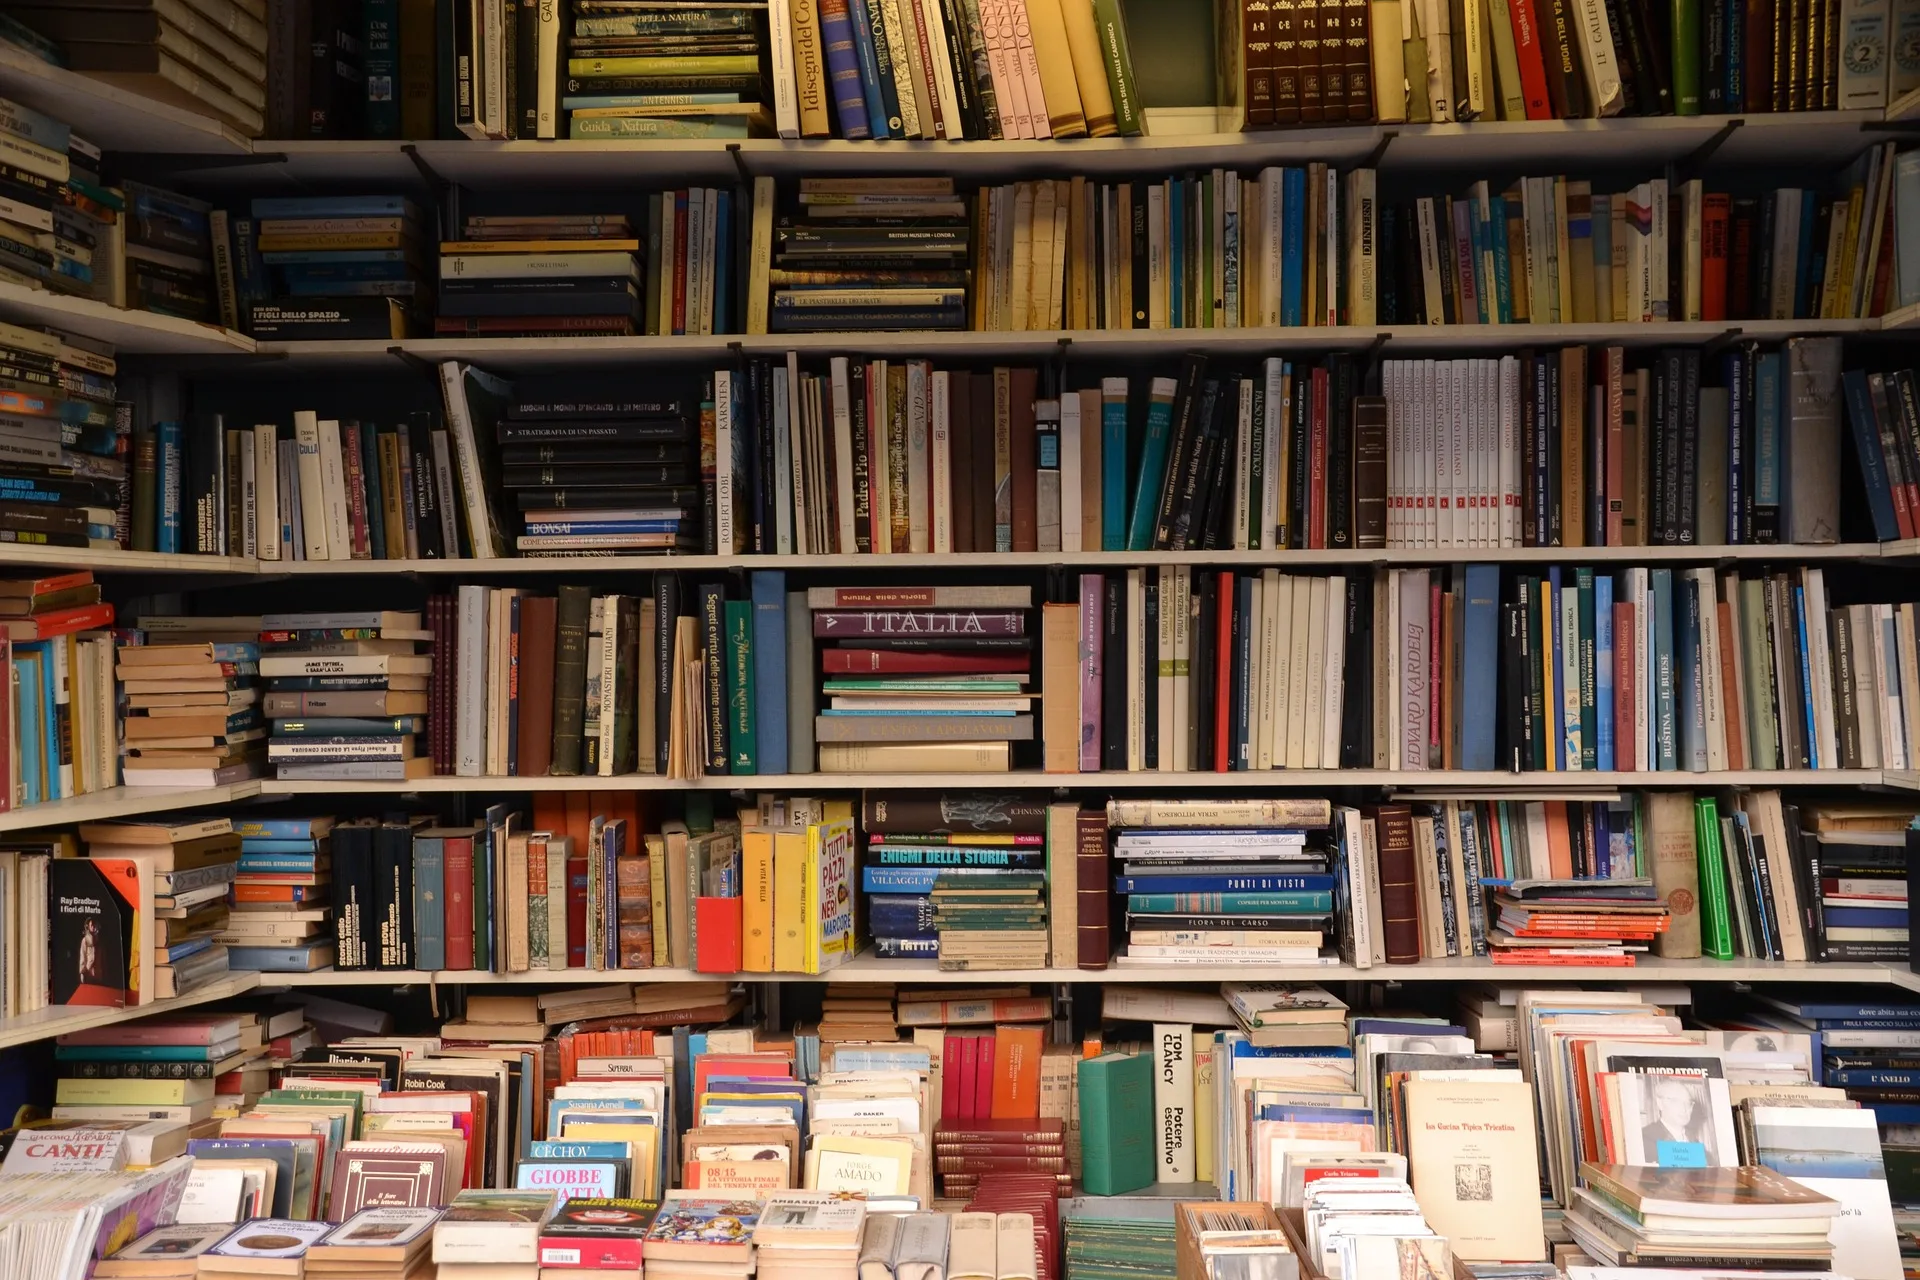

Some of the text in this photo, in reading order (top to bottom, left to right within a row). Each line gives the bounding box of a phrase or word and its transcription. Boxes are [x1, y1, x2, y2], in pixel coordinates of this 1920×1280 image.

[638, 13, 706, 22] DELLA NATURA
[1730, 14, 1739, 95] RECORDS 2007
[1858, 46, 1869, 63] 2
[459, 56, 469, 106] MAGNUS EDIZIONI
[1107, 22, 1132, 122] STORIA DELLA VALLE CAMONICA
[642, 95, 693, 105] ANTENNISTI
[580, 120, 611, 133] Guida
[620, 121, 658, 132] Natura
[1363, 198, 1371, 241] INTERNI
[1363, 242, 1371, 254] DI
[1459, 238, 1474, 299] RADICI AL SOLE
[853, 365, 863, 379] 2
[1612, 354, 1622, 432] LA CASA BIANCA
[518, 428, 565, 436] STRATIGRAFIA
[1762, 376, 1773, 499] FRIULI-VENEZIA GIULIA
[857, 441, 865, 451] da
[855, 455, 868, 477] Pio
[856, 479, 869, 518] Padre
[198, 498, 206, 551] SILVERBERG
[532, 523, 571, 535] BONSAI
[720, 503, 730, 543] ROBERT
[707, 594, 718, 625] Segreti
[862, 610, 986, 634] ITALIA
[603, 627, 613, 713] MONASTERI ITALIANI
[710, 656, 720, 677] delle
[709, 679, 721, 706] piante
[1407, 621, 1424, 766] EDVARD KARDELJ
[1661, 653, 1672, 758] BUJŠTINA IL BUIESE
[712, 708, 723, 752] medicinali
[869, 722, 918, 736] CENTO
[827, 835, 845, 859] TUTTI
[880, 849, 1009, 867] ENIGMI DELLA STORIA
[823, 857, 845, 887] PAZZI
[1466, 825, 1474, 853] TRIESTE
[1470, 872, 1479, 904] FESTIVAL
[826, 887, 834, 899] PER
[1228, 879, 1306, 889] PUNTI DI VISTA
[61, 897, 100, 906] Ray Bradbury
[821, 897, 836, 920] NERI
[1172, 1034, 1182, 1061] TOM
[1163, 1034, 1173, 1085] CLANCY
[404, 1079, 446, 1089] Robin Cook
[569, 1101, 597, 1109] Susanna
[1165, 1107, 1173, 1165] esecutivo
[1174, 1107, 1184, 1149] Potere
[1437, 1122, 1460, 1131] Cucina
[1461, 1123, 1483, 1132] Tipica
[1484, 1123, 1516, 1132] Triestina
[25, 1144, 105, 1159] CANTI
[707, 1168, 736, 1177] 08/15
[835, 1169, 882, 1181] AMADO
[846, 1161, 872, 1169] JORGE
[531, 1169, 601, 1184] GIOBBE
[1840, 1208, 1853, 1217] po'
